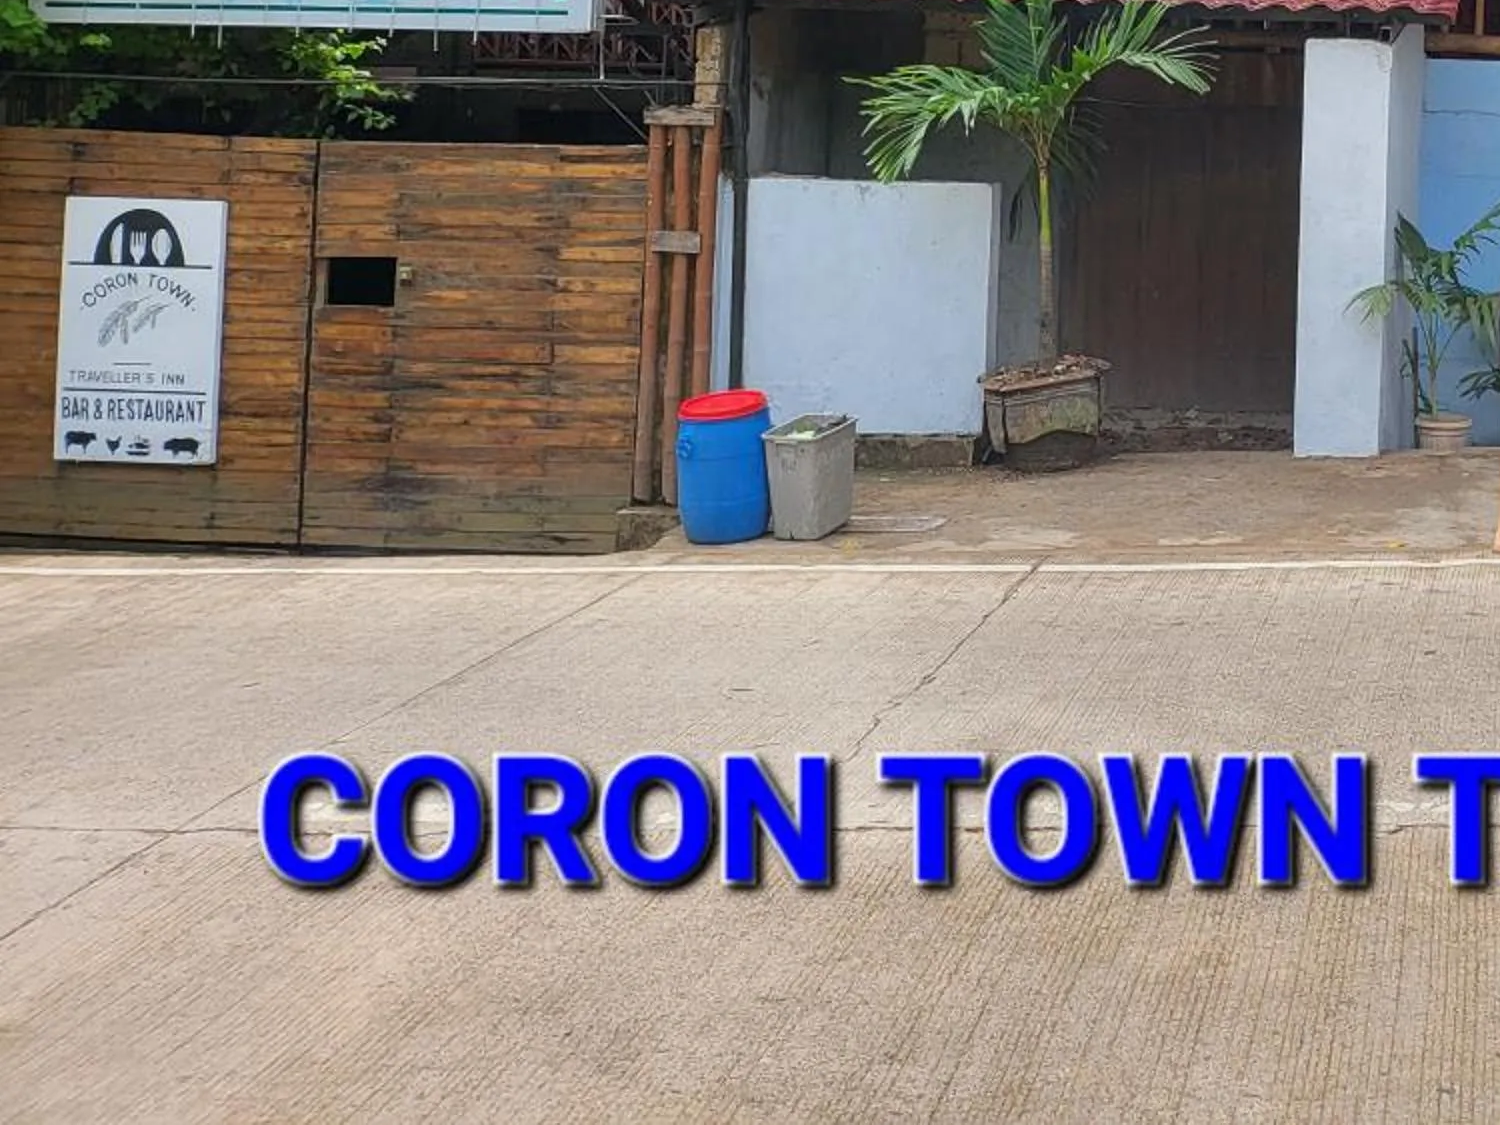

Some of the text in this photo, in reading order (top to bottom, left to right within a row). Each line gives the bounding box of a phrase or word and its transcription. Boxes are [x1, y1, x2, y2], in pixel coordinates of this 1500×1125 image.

[82, 272, 196, 308] CORON TOWN
[68, 370, 185, 386] TRAVELLER'S INN
[61, 396, 206, 424] BAR & RESTAURANT
